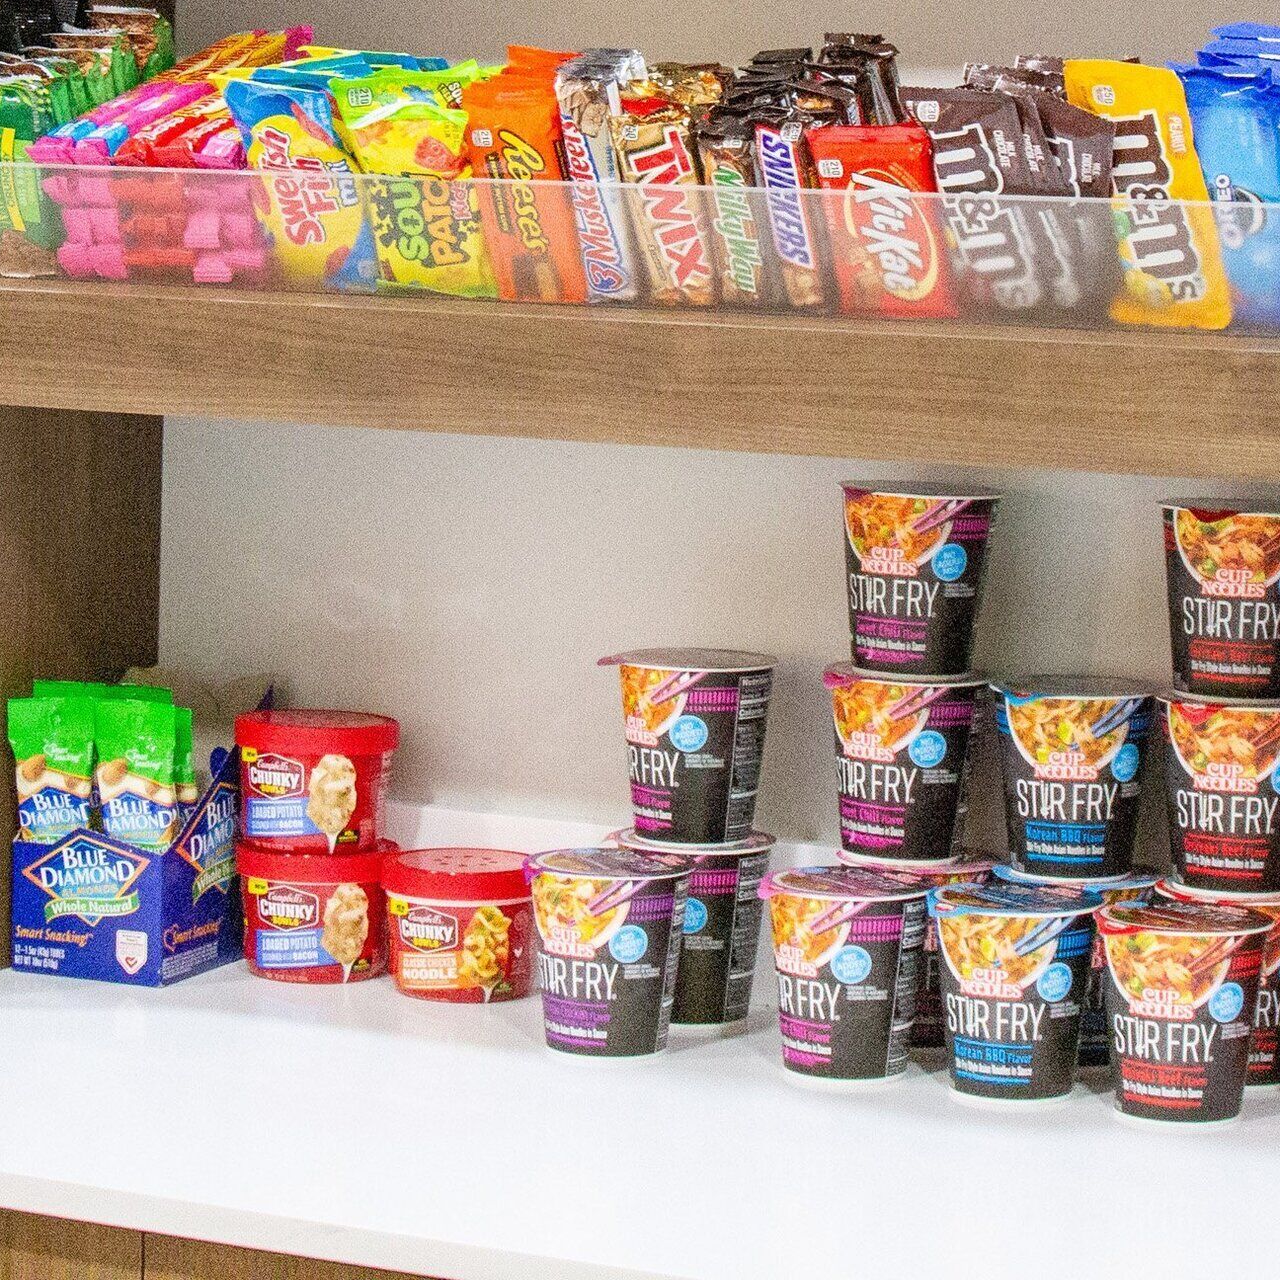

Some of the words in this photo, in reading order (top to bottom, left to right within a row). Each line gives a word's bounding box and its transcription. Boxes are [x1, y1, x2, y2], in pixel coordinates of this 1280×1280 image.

[1169, 114, 1187, 154] PEANUT
[992, 130, 1012, 168] CHOCOLATE
[829, 160, 839, 176] 210
[499, 130, 549, 254] Reese's
[761, 133, 811, 266] SNICKERS
[631, 128, 712, 287] TWIX
[590, 262, 624, 290] 3
[870, 547, 905, 561] CUP
[861, 558, 918, 576] NOODLES
[1216, 567, 1254, 584] CUP
[849, 573, 886, 615] STIR
[892, 578, 940, 618] FRY
[1201, 582, 1266, 598] NOODLES
[1182, 596, 1232, 639] STIR
[851, 732, 882, 747] CUP
[843, 744, 897, 762] NOODLES
[1048, 752, 1085, 765] CUP
[638, 747, 680, 788] FRY
[1034, 763, 1099, 781] NOODLES
[1207, 761, 1244, 778] CUP
[250, 766, 300, 789] CHUNKY
[871, 764, 918, 803] FRY
[1193, 776, 1259, 793] NOODLES
[33, 794, 71, 811] BLUE
[109, 800, 150, 818] BLUE
[1017, 779, 1065, 819] STIR
[1072, 782, 1118, 820] FRY
[106, 810, 173, 830] IAMOND
[276, 805, 303, 818] POTATO
[1176, 790, 1224, 833] STIR
[1230, 795, 1279, 835] FRY
[1025, 828, 1060, 843] Korean
[1061, 828, 1082, 843] BBQ
[62, 847, 108, 868] BLUE
[40, 863, 135, 889] DIAMOND
[52, 900, 86, 914] Whole
[89, 899, 132, 913] Natural
[260, 903, 315, 922] CHUNKY
[15, 925, 44, 939] Smart
[45, 928, 89, 947] Snacking!
[401, 919, 453, 942] CHUNKY
[551, 928, 582, 943] CUP
[291, 937, 318, 950] POTATO
[545, 940, 595, 959] NOODLES
[779, 946, 805, 957] CUP
[402, 967, 457, 980] NOODLE
[537, 950, 567, 998] STIR
[572, 961, 618, 1000] FRY
[972, 968, 1009, 983] CUP
[960, 980, 1023, 999] NOODLES
[1141, 988, 1181, 1005] CUP
[796, 980, 842, 1021] FRY
[946, 993, 990, 1040] STIR
[997, 1001, 1046, 1041] FRY
[1128, 1003, 1195, 1020] NOODLES
[1113, 1013, 1161, 1059] STIR
[1167, 1023, 1218, 1063] FRY
[955, 1043, 983, 1061] Korean
[985, 1045, 1007, 1062] BBQ
